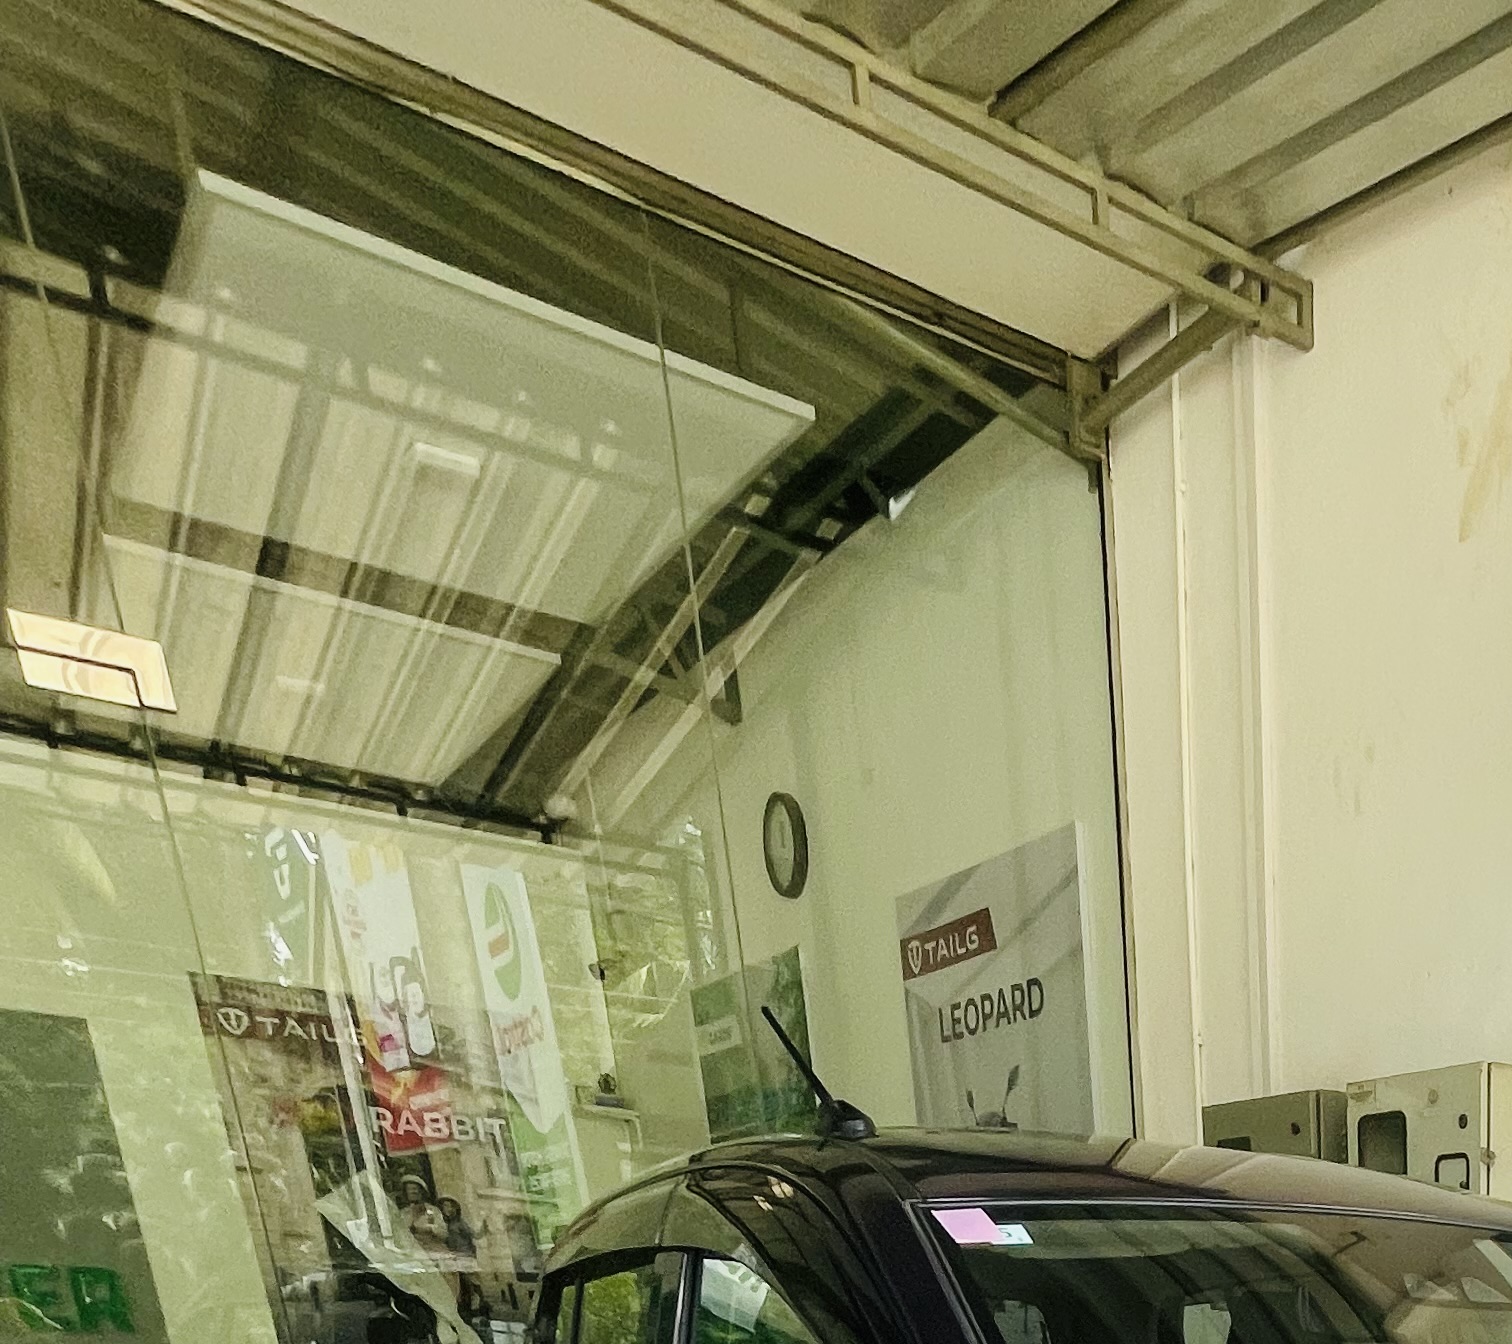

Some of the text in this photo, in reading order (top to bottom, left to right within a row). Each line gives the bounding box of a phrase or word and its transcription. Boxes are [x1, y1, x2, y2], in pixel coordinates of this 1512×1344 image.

[924, 925, 979, 965] TAILG
[938, 977, 1044, 1043] LEOPARD
[255, 1016, 360, 1045] TAIL
[368, 1105, 506, 1143] RABBIT
